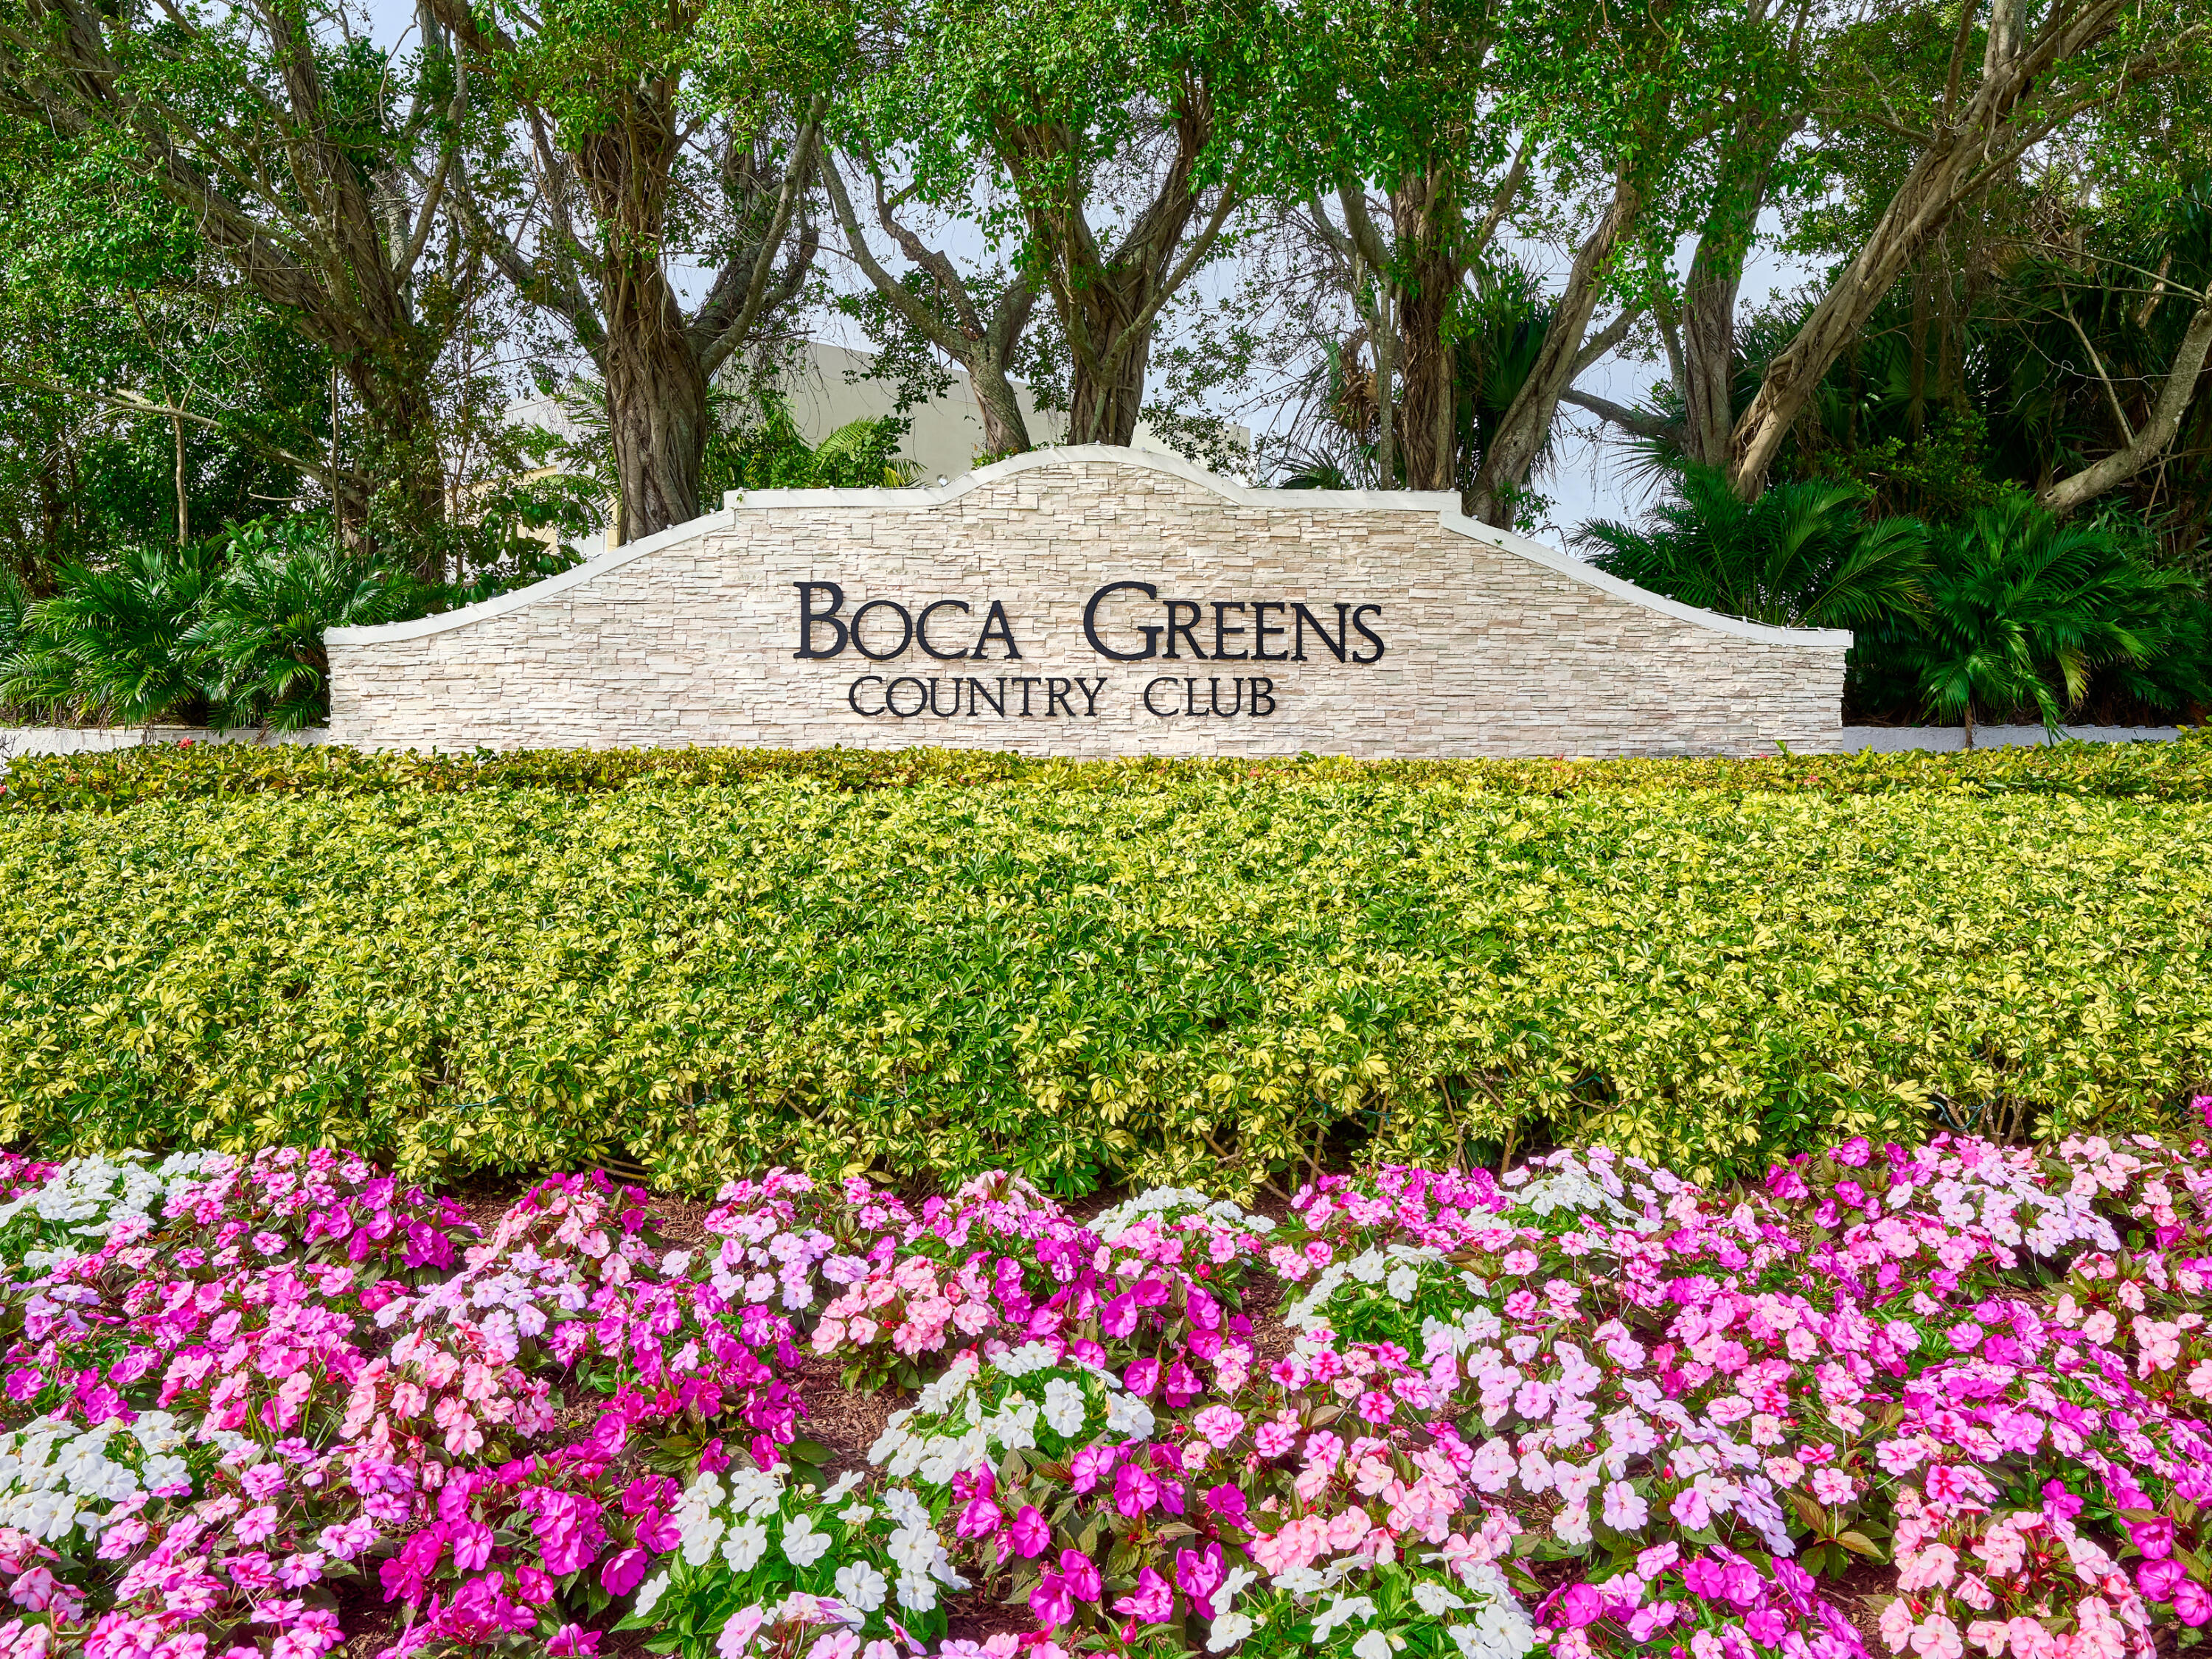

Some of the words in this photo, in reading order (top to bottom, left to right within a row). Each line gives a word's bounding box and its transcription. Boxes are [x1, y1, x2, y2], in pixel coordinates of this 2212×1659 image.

[793, 581, 1023, 663] BOCA
[1082, 580, 1385, 665] GREENS
[848, 675, 1108, 719] COUNTRY
[1144, 675, 1276, 718] CLUB
